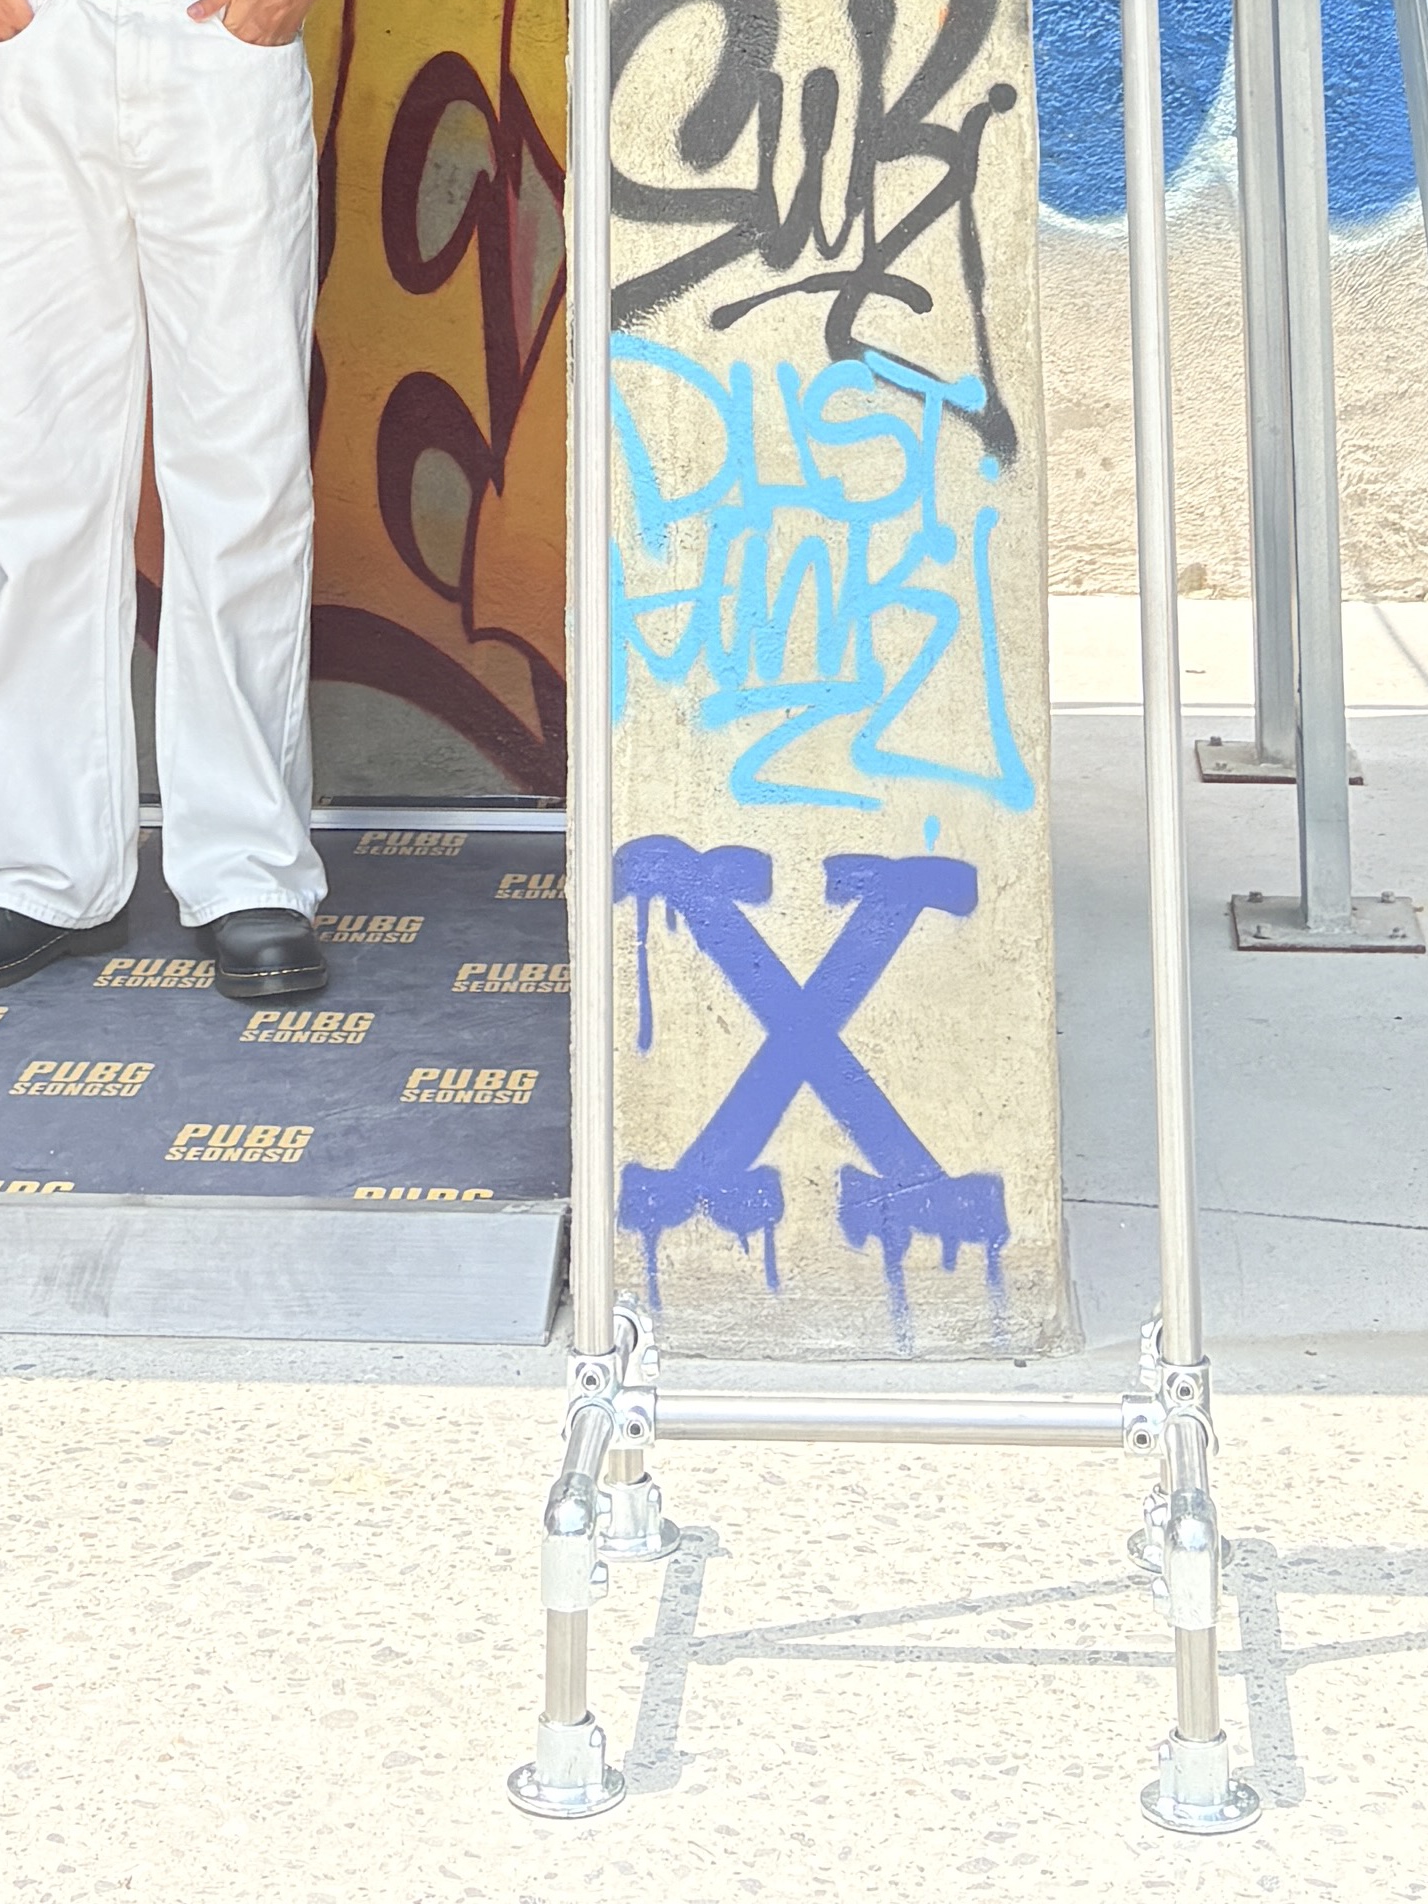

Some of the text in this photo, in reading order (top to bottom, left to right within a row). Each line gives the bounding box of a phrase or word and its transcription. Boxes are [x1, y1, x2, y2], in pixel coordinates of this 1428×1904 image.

[357, 831, 469, 849] PUBG
[352, 846, 462, 857] SEONGSU
[498, 872, 567, 892] PU
[314, 914, 426, 935] PUBG
[99, 957, 216, 979] PUBG
[455, 962, 572, 983] PUBG
[93, 973, 215, 989] SEONGSU
[451, 979, 572, 994] SEONGSU
[246, 1010, 376, 1033] PUBG
[239, 1028, 367, 1045] SEONGSU
[18, 1060, 155, 1084] PUBG
[407, 1067, 540, 1091] PUBG
[8, 1080, 142, 1098] SEONGSU
[400, 1087, 533, 1105] SEONGSU
[173, 1123, 316, 1149] PUBG
[164, 1145, 305, 1164] SEONGSU
